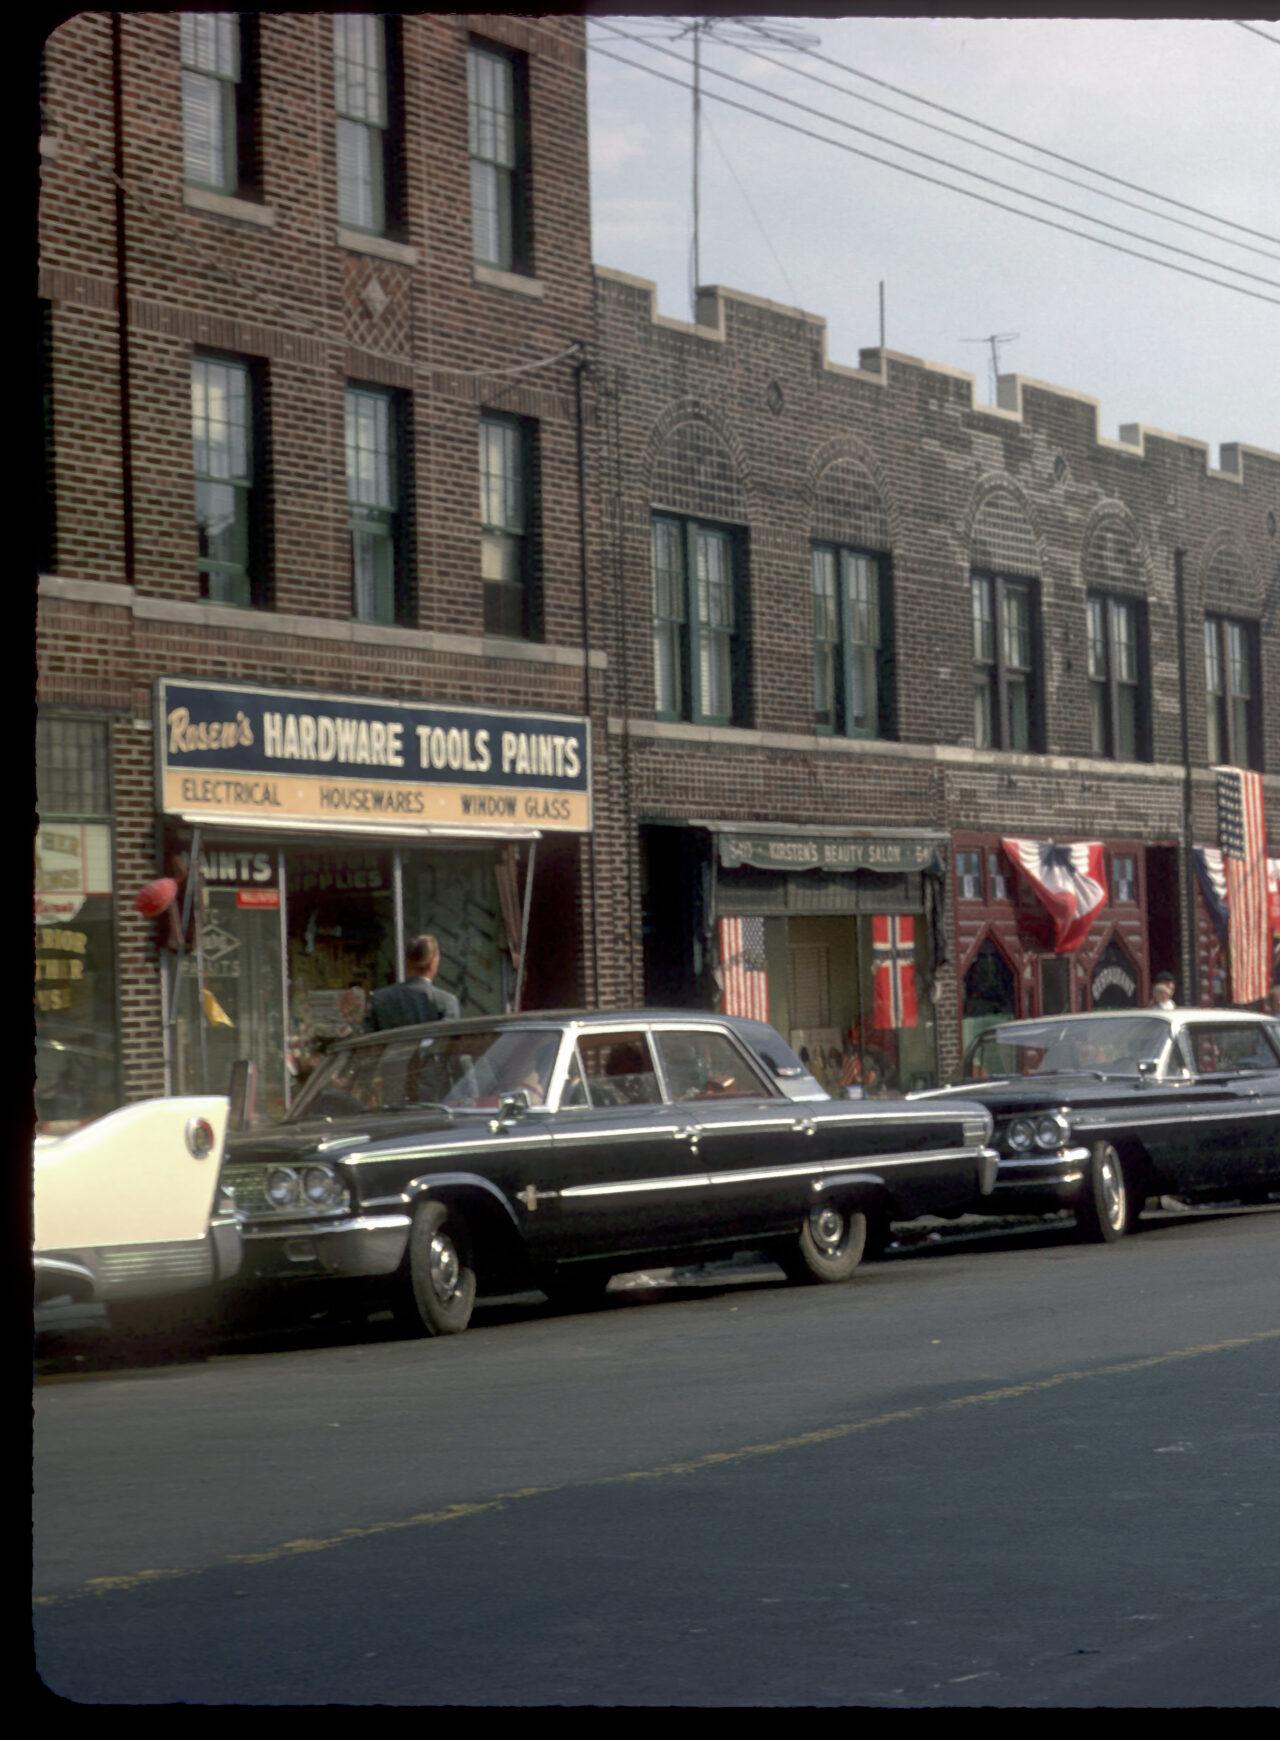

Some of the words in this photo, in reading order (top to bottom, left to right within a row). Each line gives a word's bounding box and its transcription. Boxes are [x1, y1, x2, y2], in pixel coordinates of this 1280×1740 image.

[168, 707, 254, 753] Rosen's
[263, 711, 404, 768] HARDWARE
[415, 724, 492, 773] TOOLS
[502, 730, 581, 779] PAINTS
[182, 777, 282, 806] ELECTRICAL
[319, 785, 425, 814] HOUSEWARES
[461, 793, 518, 818] WINDOW
[524, 796, 571, 820] GLASS
[768, 840, 818, 863] KIRSTEN'S
[824, 844, 864, 863] BEAUTY
[868, 845, 900, 863] SALON
